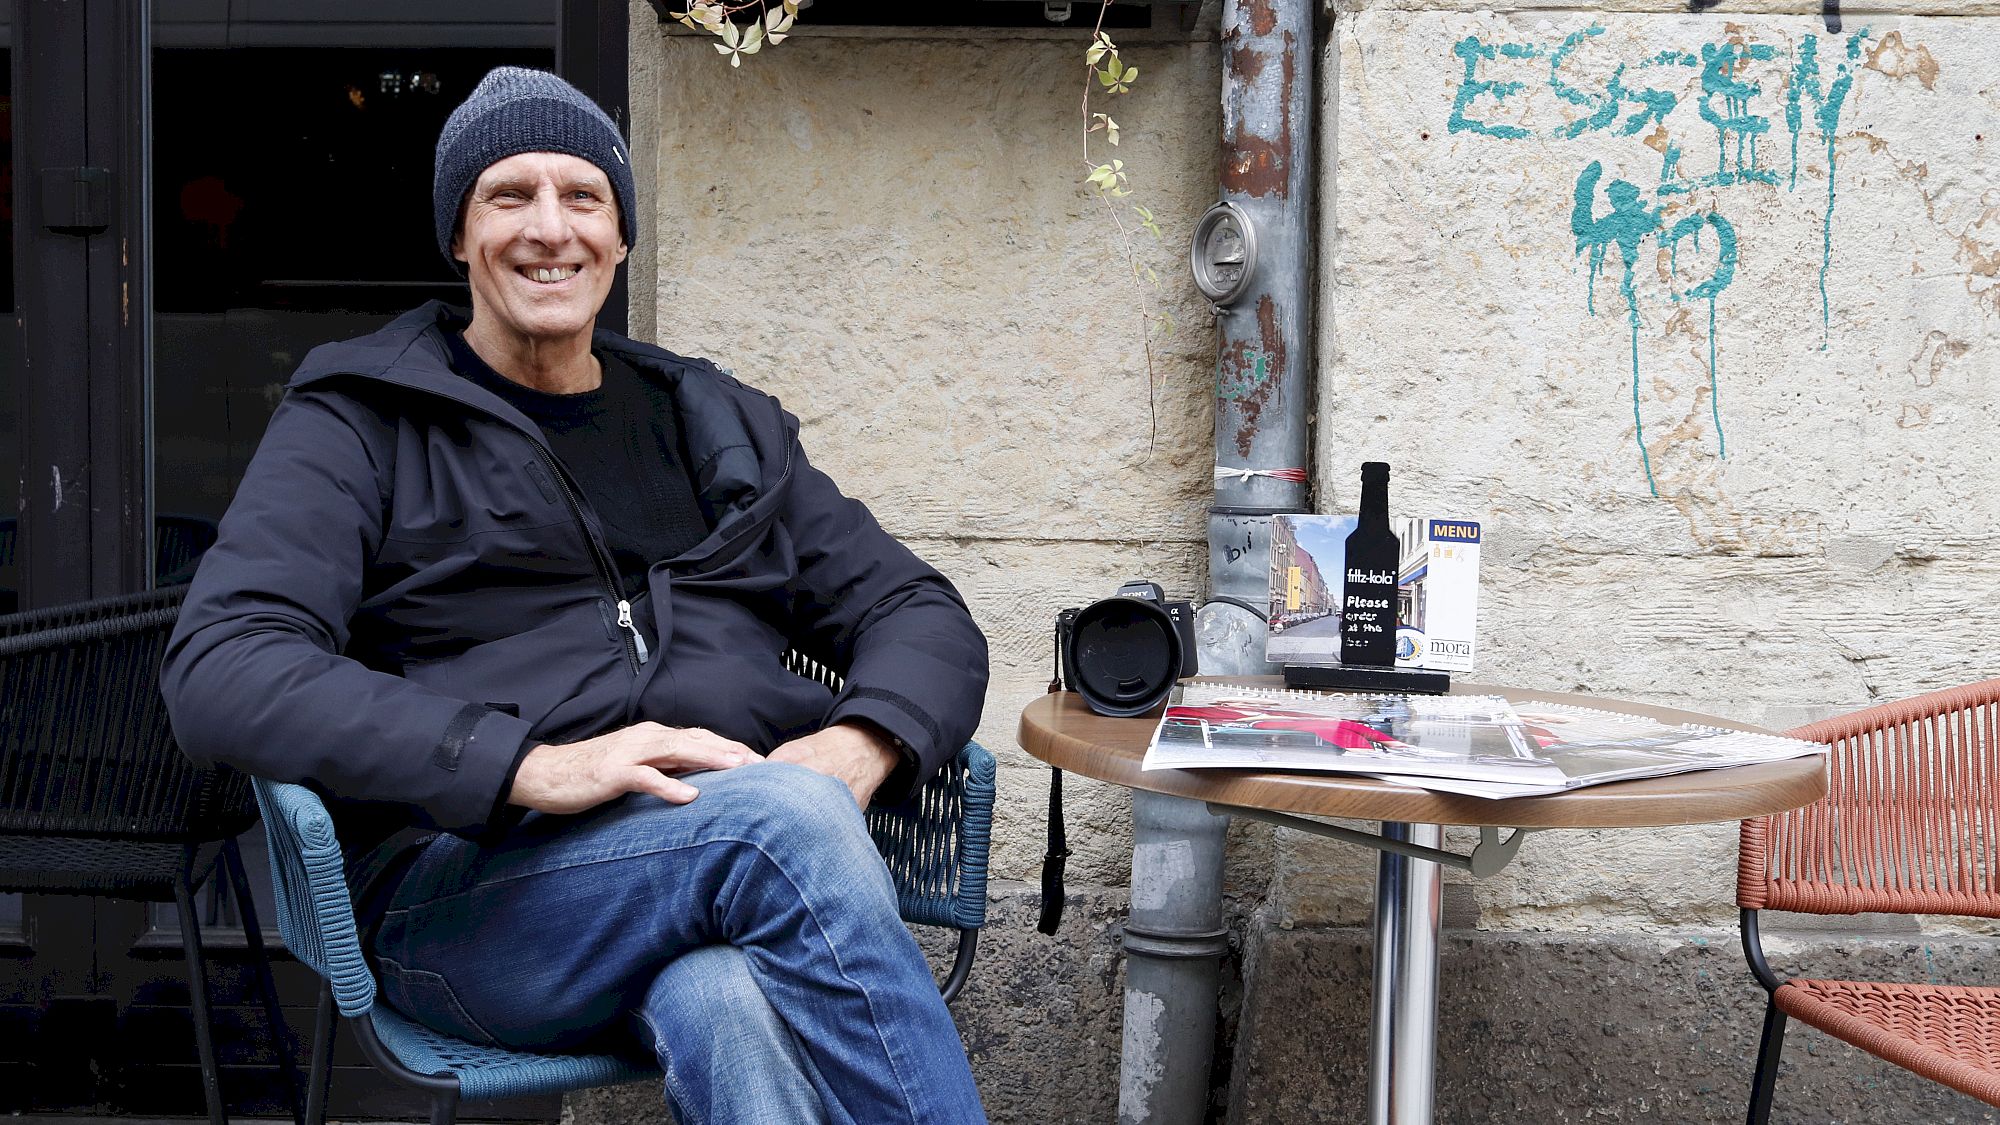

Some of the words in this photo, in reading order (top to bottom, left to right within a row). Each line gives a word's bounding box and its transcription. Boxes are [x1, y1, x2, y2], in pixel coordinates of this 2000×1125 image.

[1434, 524, 1478, 539] MENU
[1346, 595, 1389, 608] Please
[1345, 611, 1378, 622] order
[1347, 623, 1358, 633] at
[1363, 623, 1383, 633] the
[1431, 641, 1470, 655] mora
